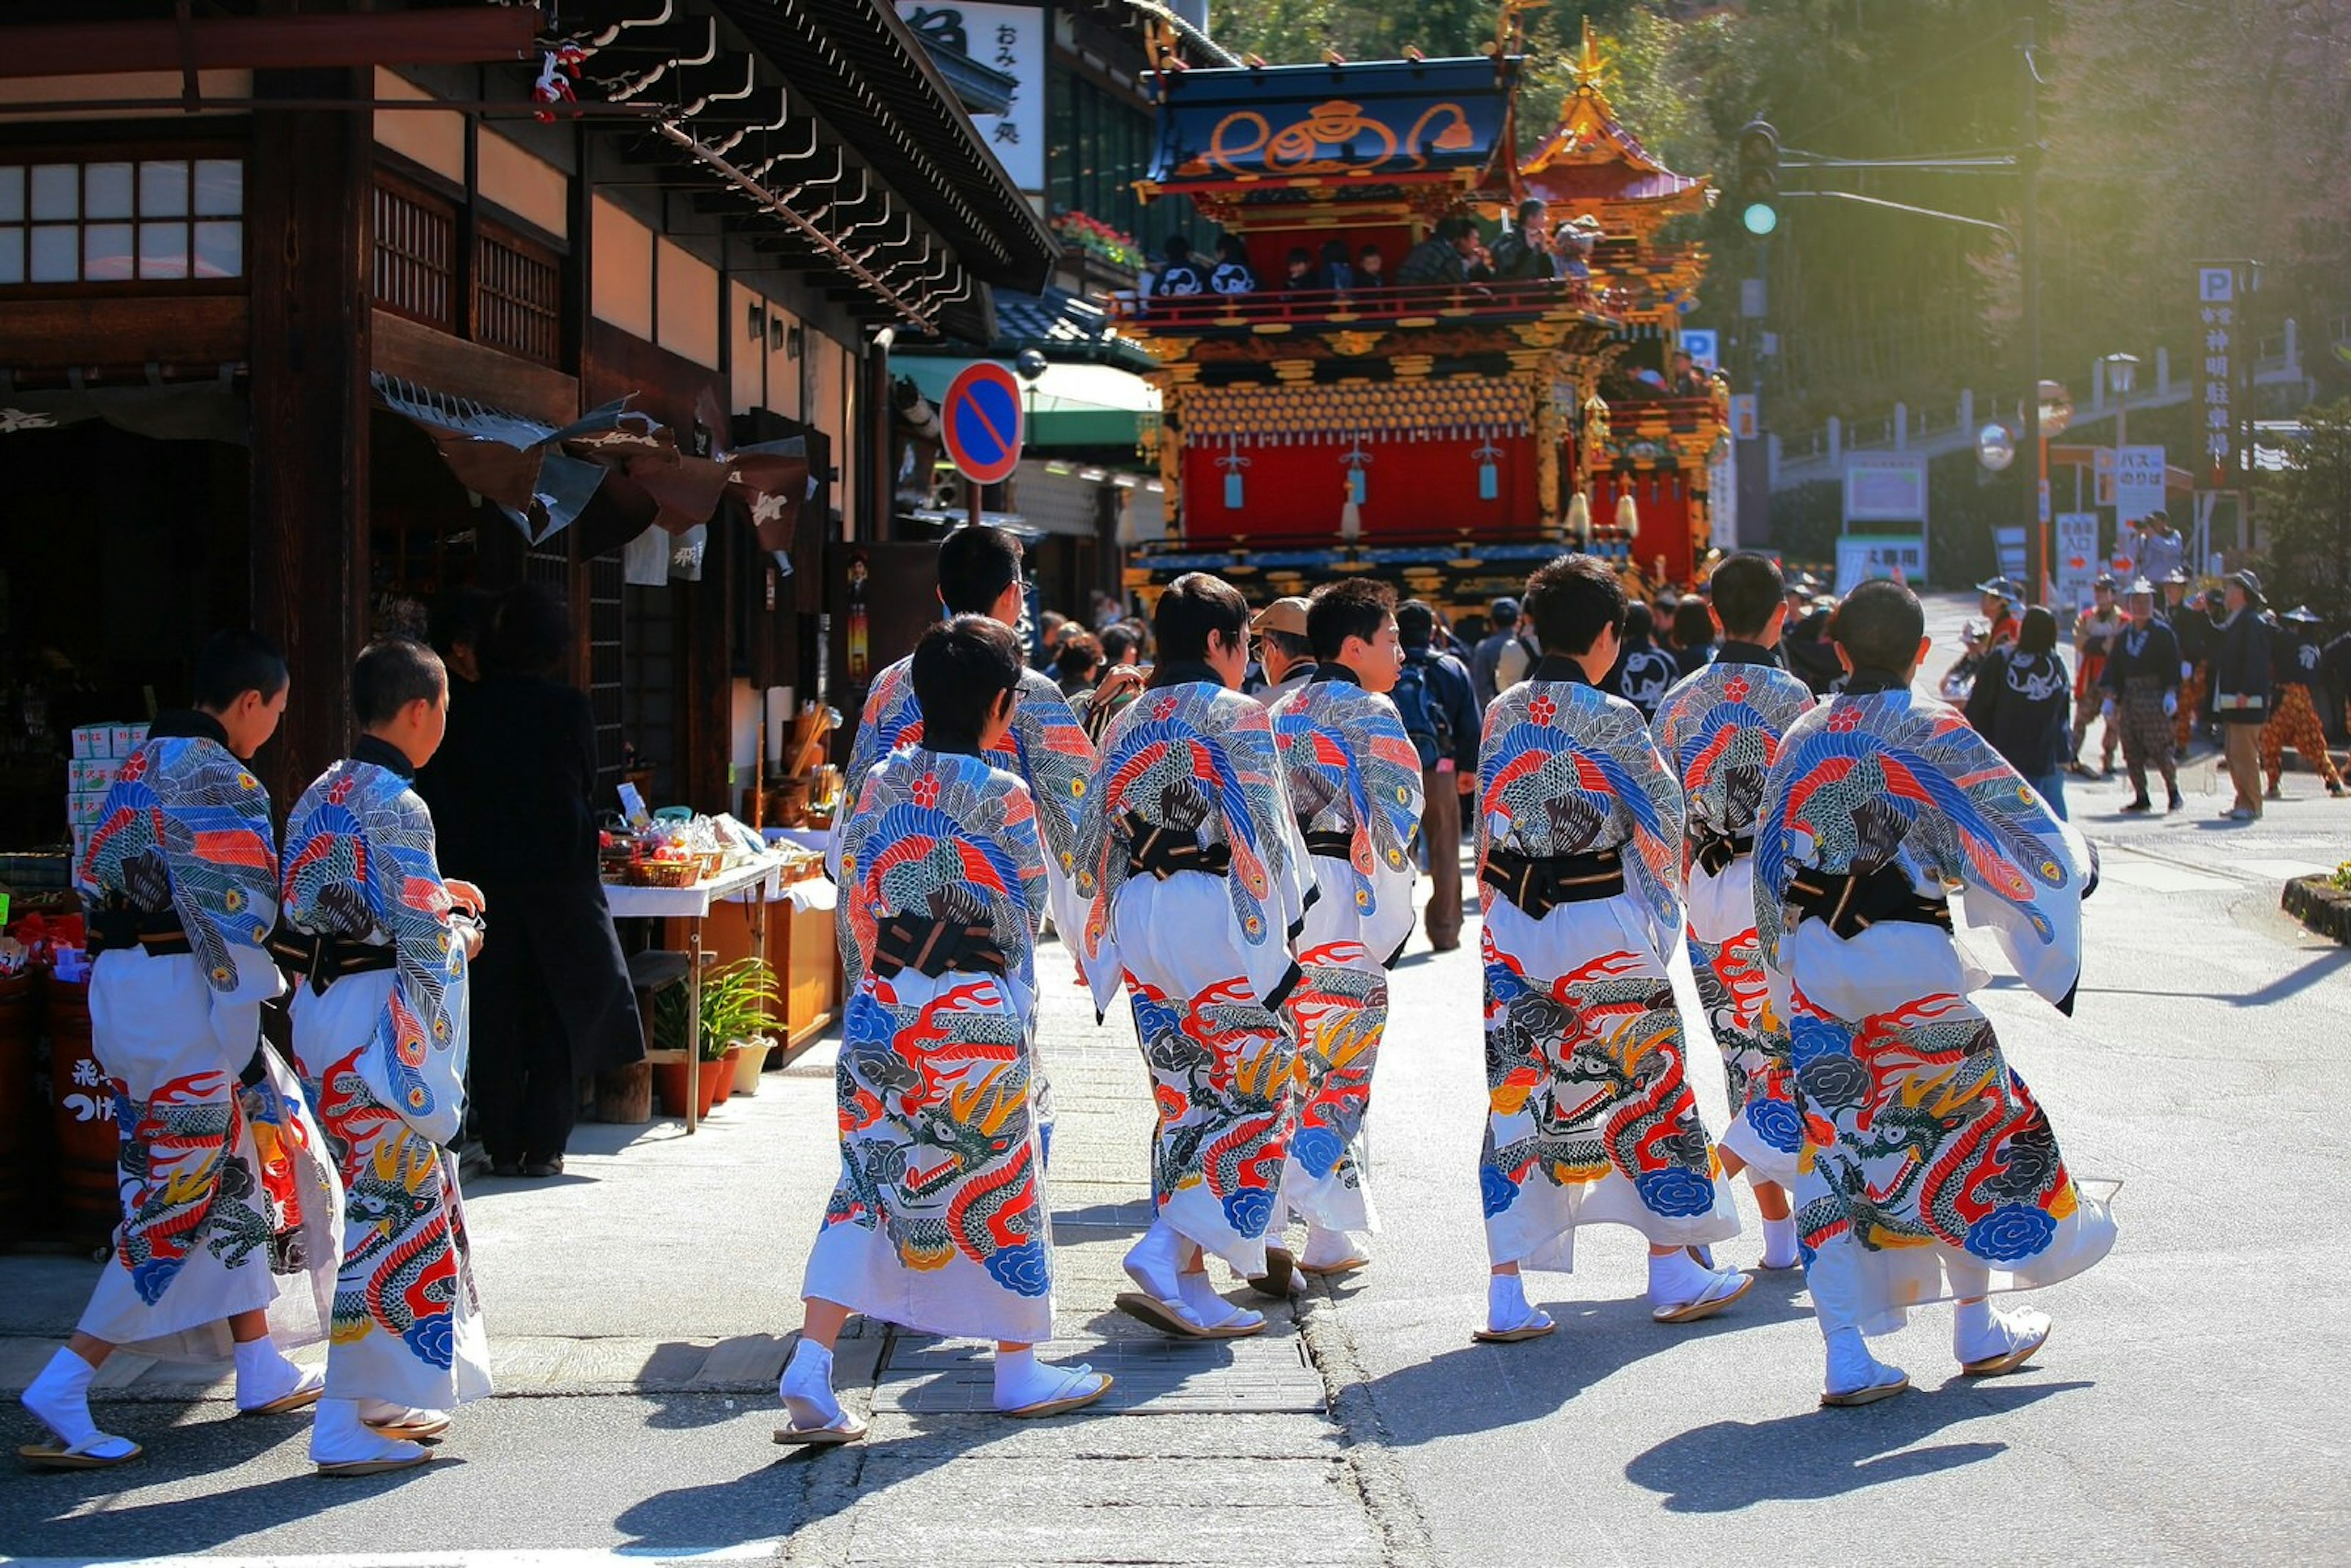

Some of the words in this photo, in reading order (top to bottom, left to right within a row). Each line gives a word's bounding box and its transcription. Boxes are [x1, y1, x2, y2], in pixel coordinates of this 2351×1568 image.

[994, 24, 1020, 144] おみ処
[2207, 274, 2229, 298] P
[72, 1059, 112, 1087] 飛
[63, 1093, 118, 1122] つけ
